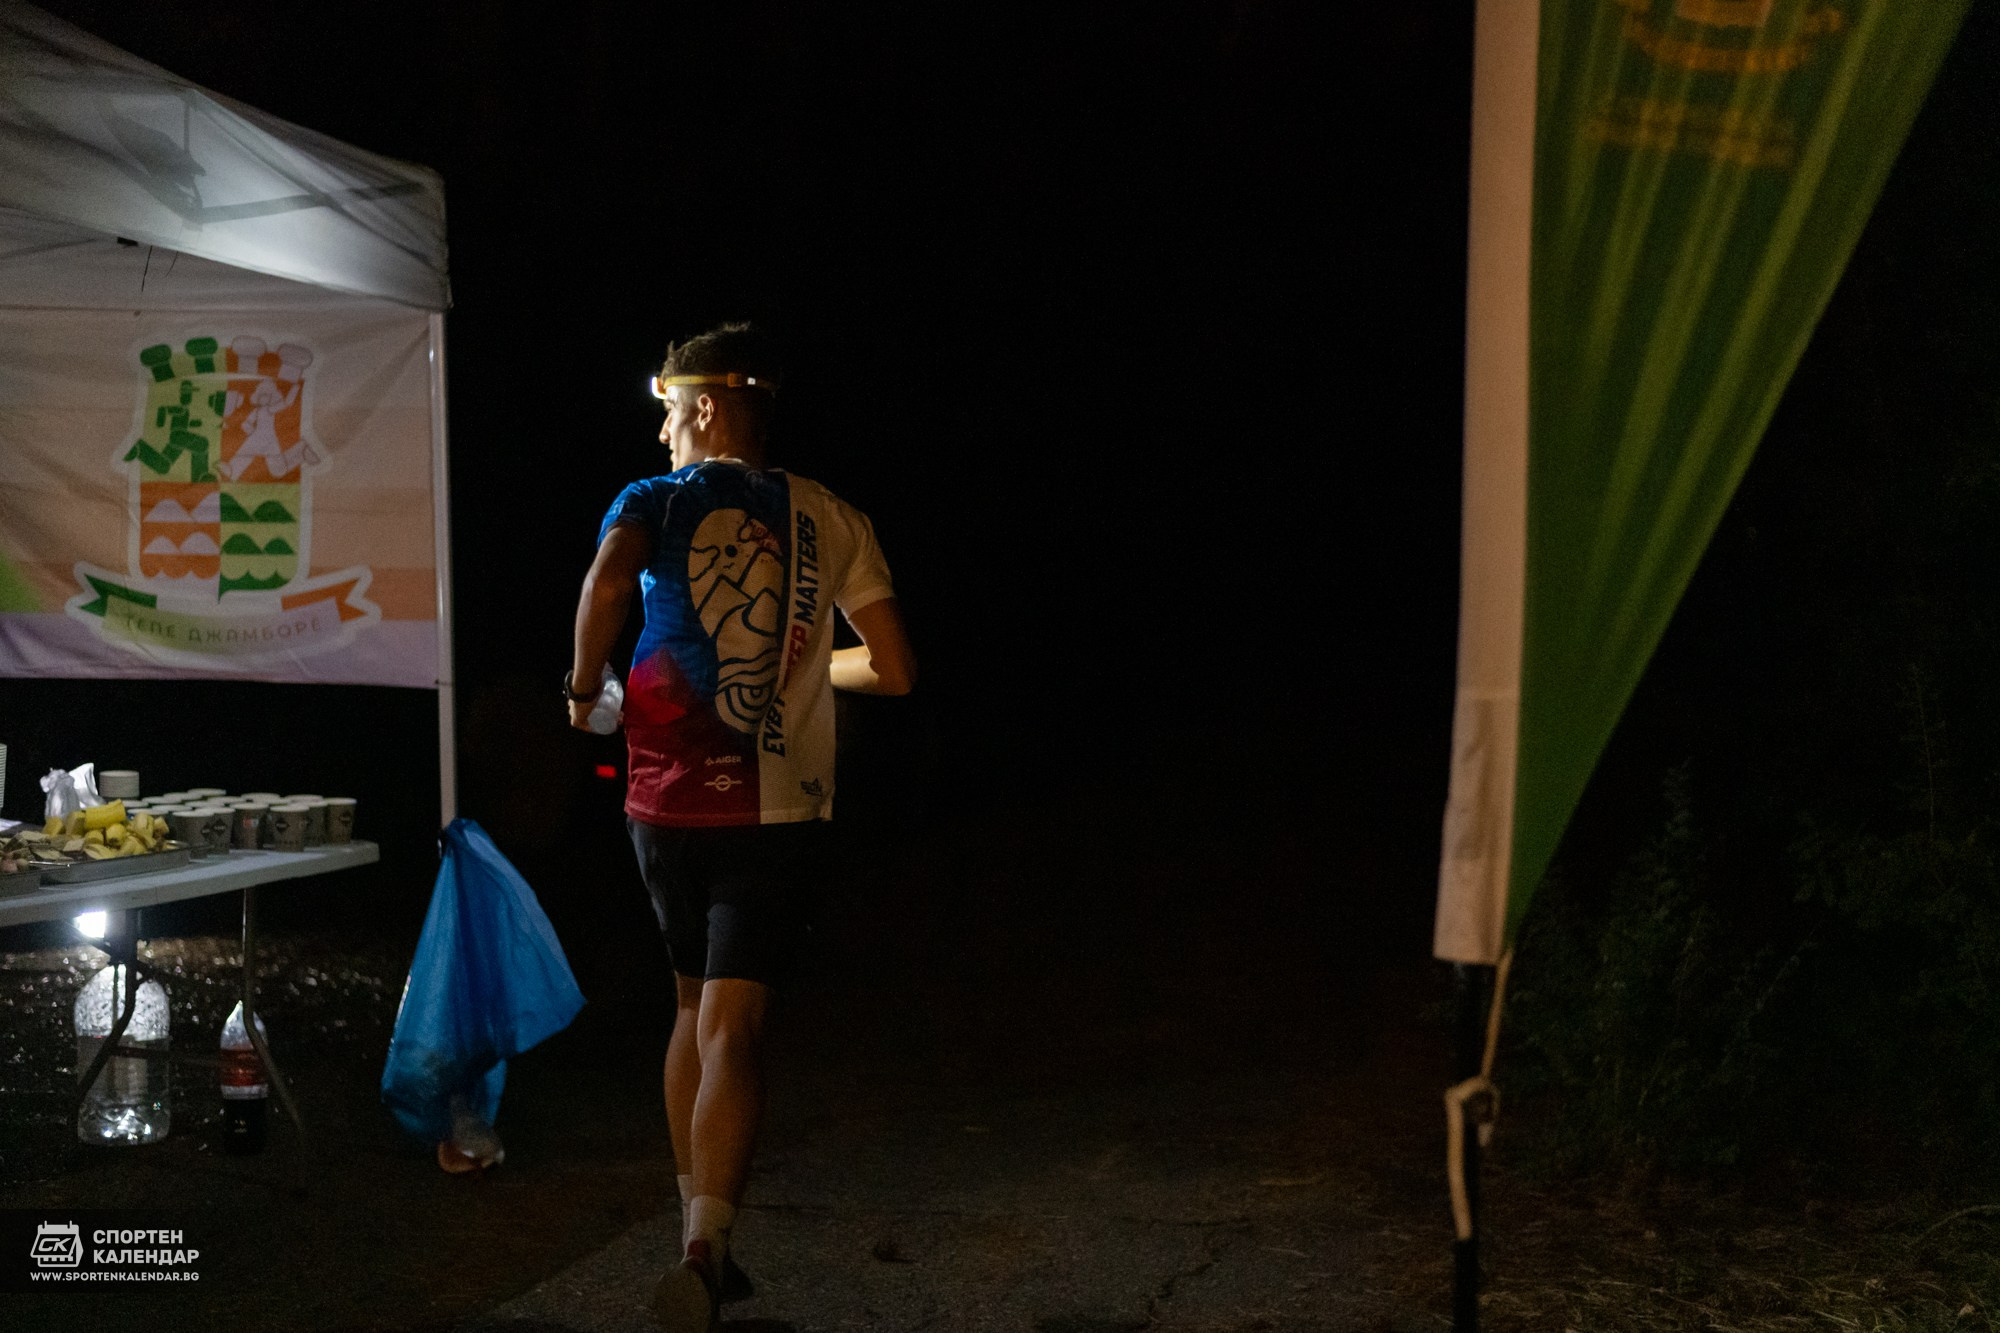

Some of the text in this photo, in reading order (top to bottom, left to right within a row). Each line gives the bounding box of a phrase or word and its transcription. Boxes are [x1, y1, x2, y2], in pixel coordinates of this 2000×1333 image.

[794, 511, 818, 626] MATTERS
[126, 615, 321, 643] ТЕПЕ ДЖАМБОРЕ
[783, 625, 807, 690] TEP
